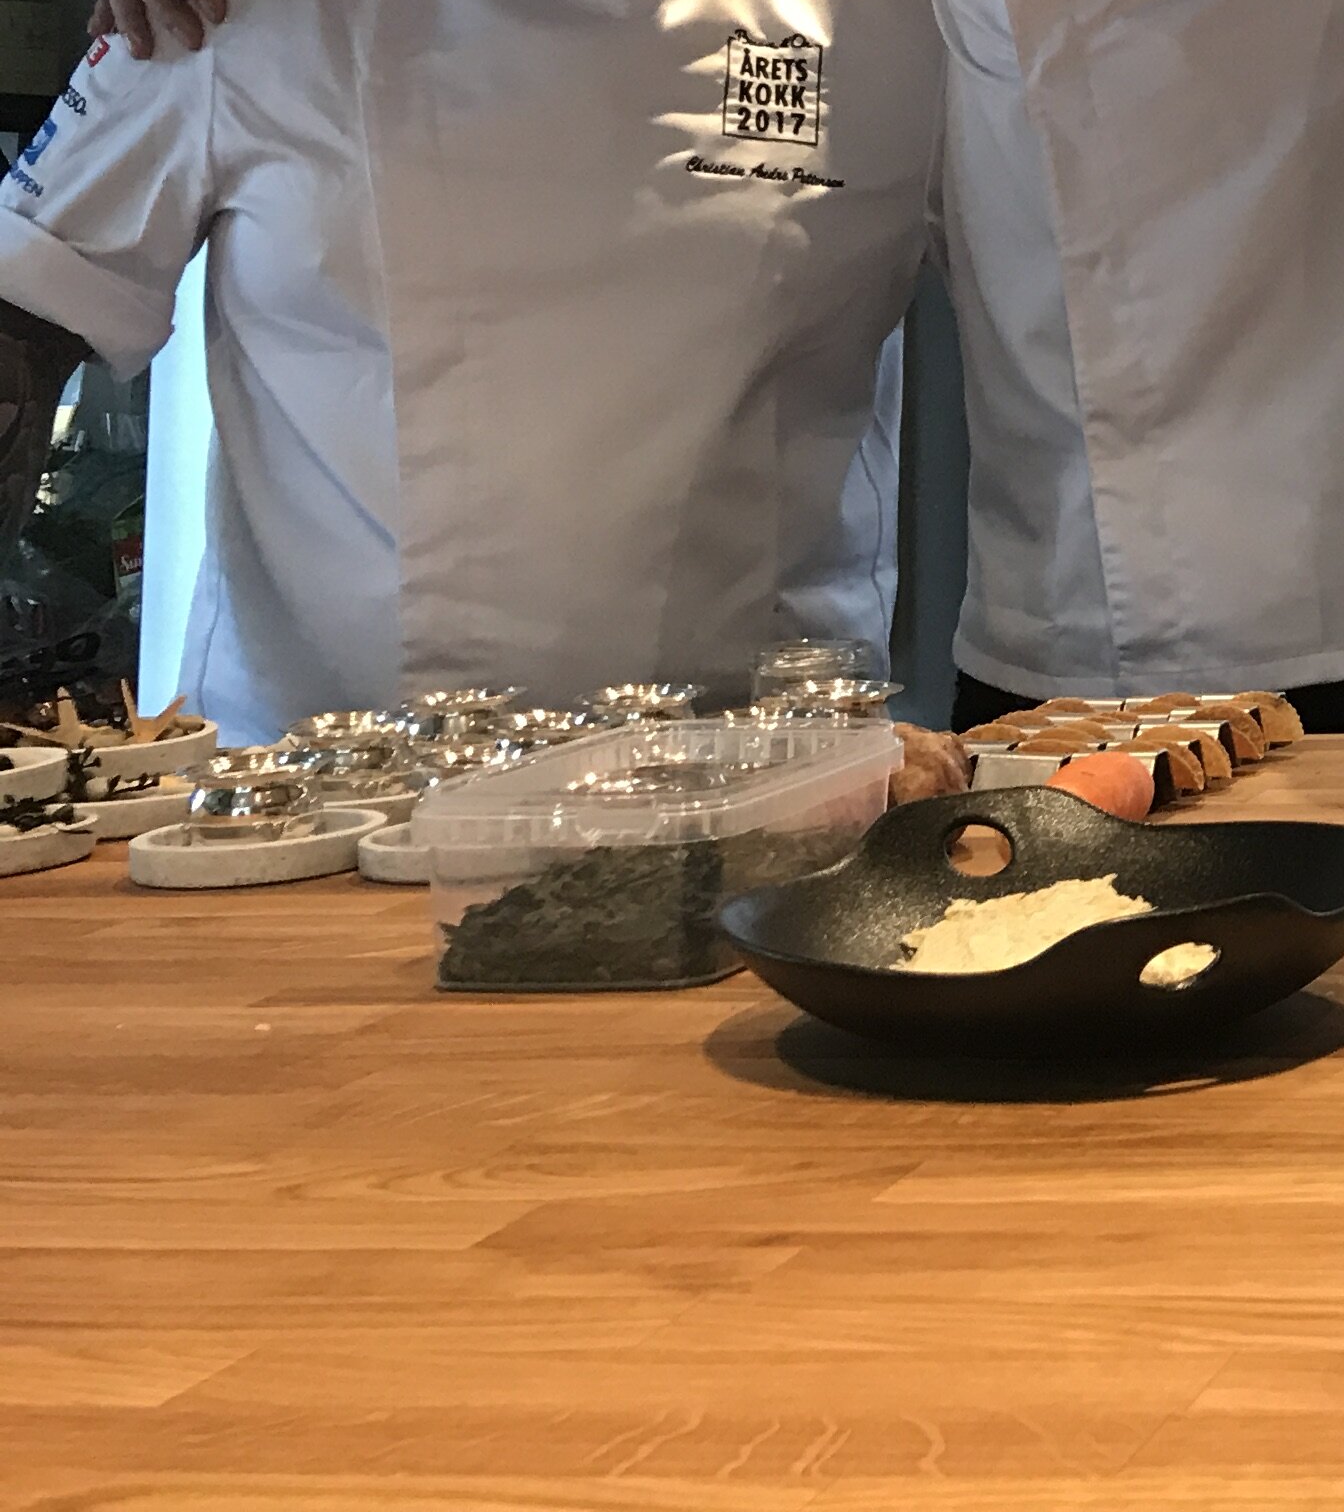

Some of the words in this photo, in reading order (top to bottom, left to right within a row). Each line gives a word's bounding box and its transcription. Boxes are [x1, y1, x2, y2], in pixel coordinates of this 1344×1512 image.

[740, 48, 808, 81] ÅRETS
[738, 80, 806, 108] KOKK
[737, 107, 806, 135] 2017
